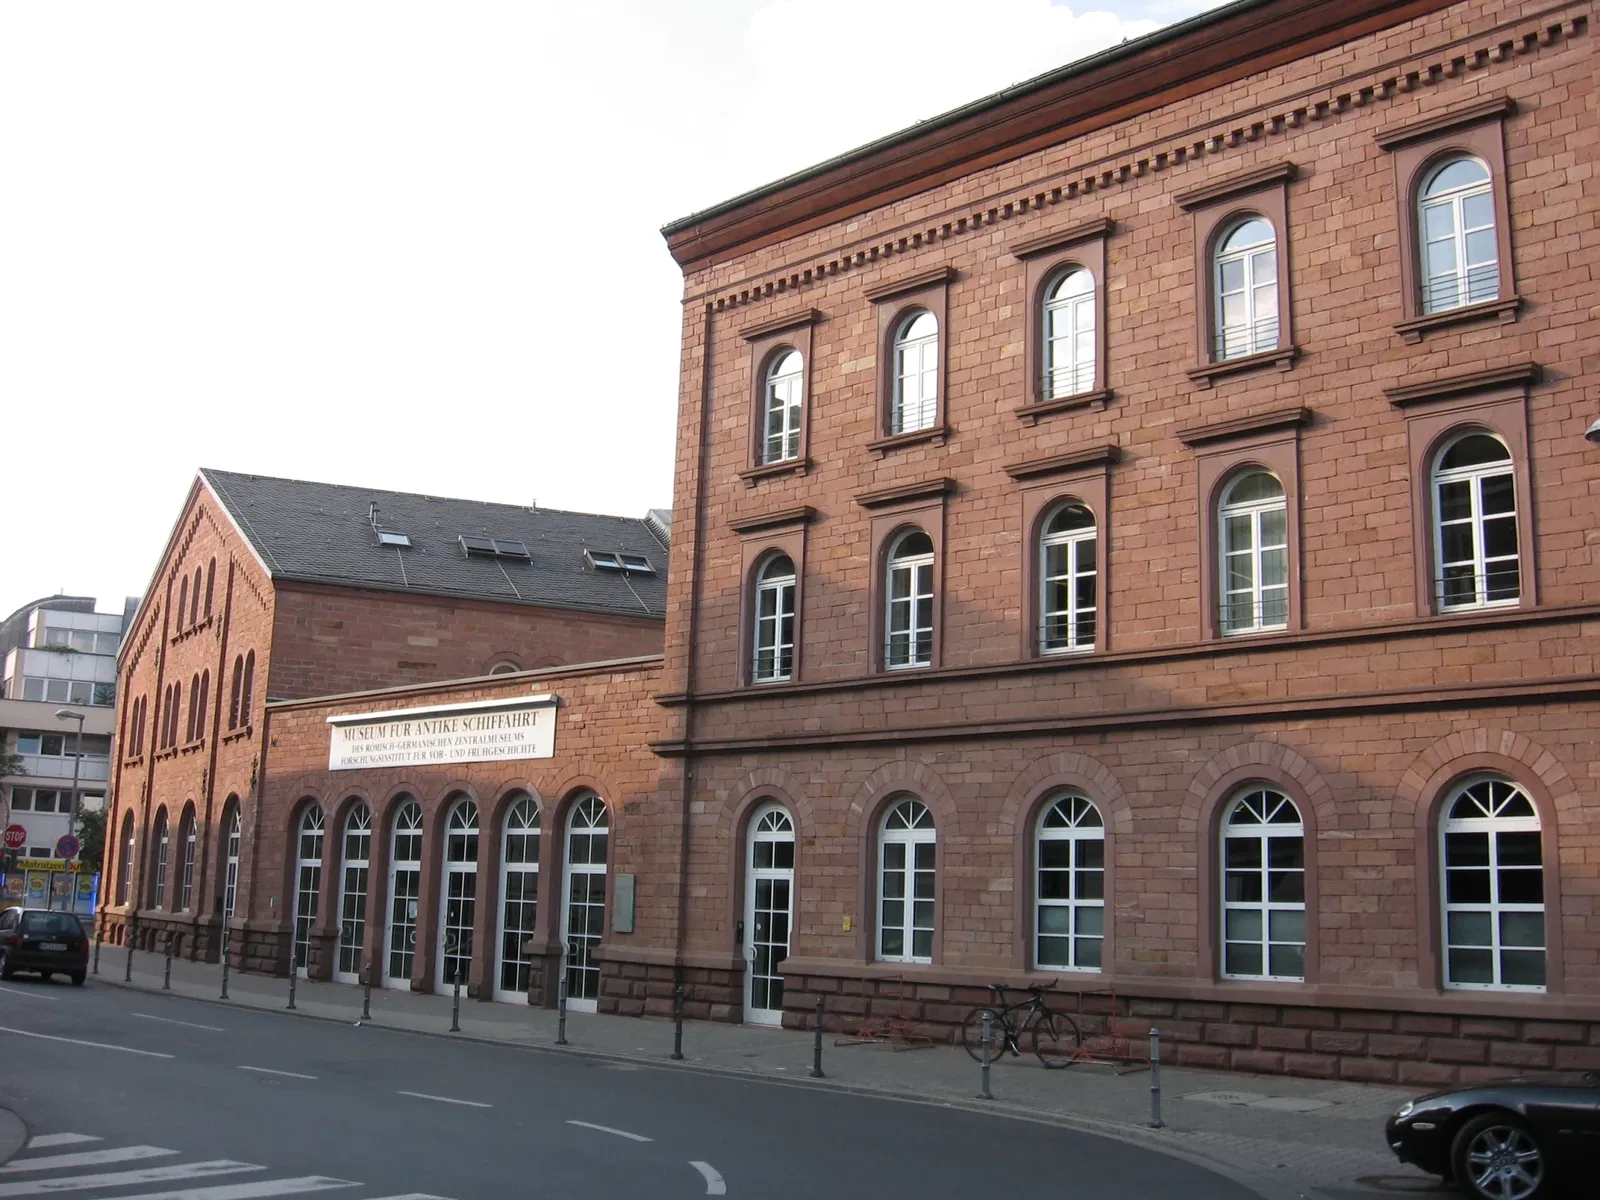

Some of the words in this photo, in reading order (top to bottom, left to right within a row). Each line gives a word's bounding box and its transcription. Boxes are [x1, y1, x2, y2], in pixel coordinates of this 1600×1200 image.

[343, 725, 386, 742] MUSEUM
[415, 718, 459, 735] ANTIKE
[462, 711, 540, 732] SCHIFFAHRT
[352, 744, 363, 753] DES
[455, 732, 525, 746] ZENTRALMUSEUMS
[450, 749, 466, 758] UND
[6, 831, 25, 842] STOP
